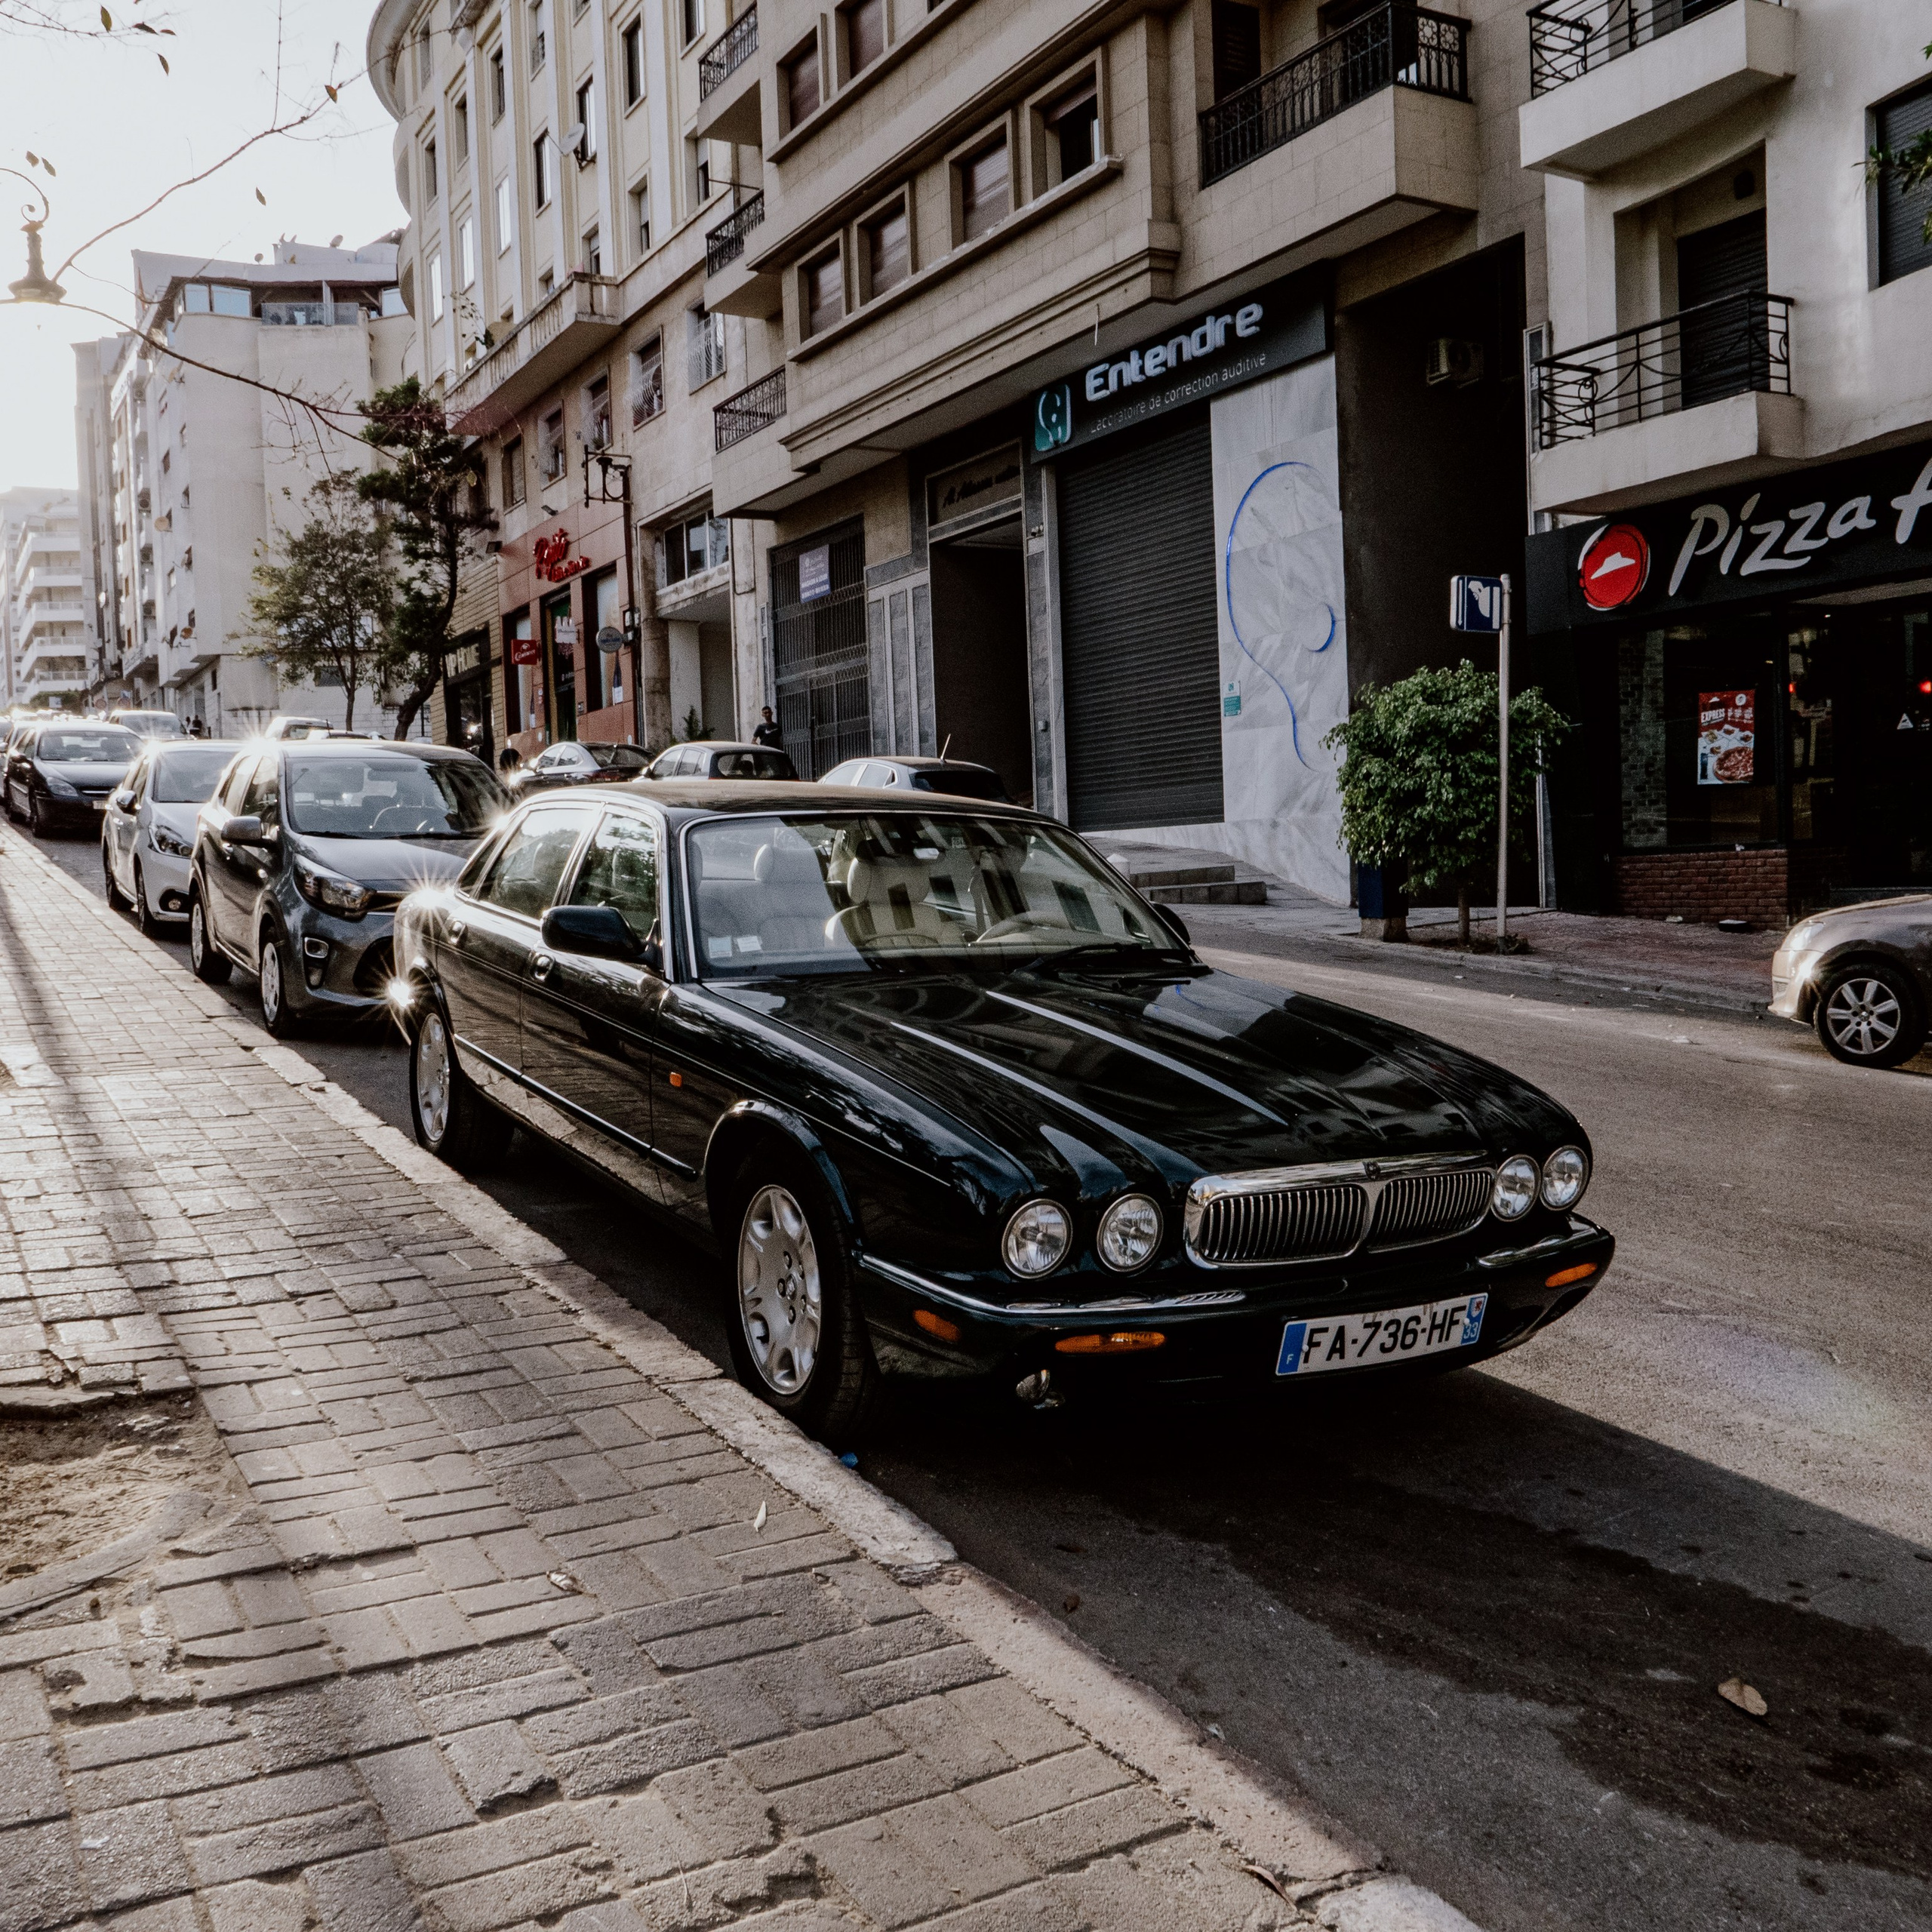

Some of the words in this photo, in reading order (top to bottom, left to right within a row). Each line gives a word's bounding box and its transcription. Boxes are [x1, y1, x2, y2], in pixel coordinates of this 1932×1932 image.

[1085, 303, 1263, 402] Entendre
[1149, 392, 1161, 410] de
[1164, 372, 1219, 405] correction
[1221, 352, 1266, 381] auditive
[1668, 492, 1877, 596] Pizza
[1700, 707, 1726, 724] EXPRESS
[1286, 1353, 1294, 1365] F
[1302, 1305, 1467, 1364] FA-736-HF
[1463, 1321, 1479, 1340] 33
